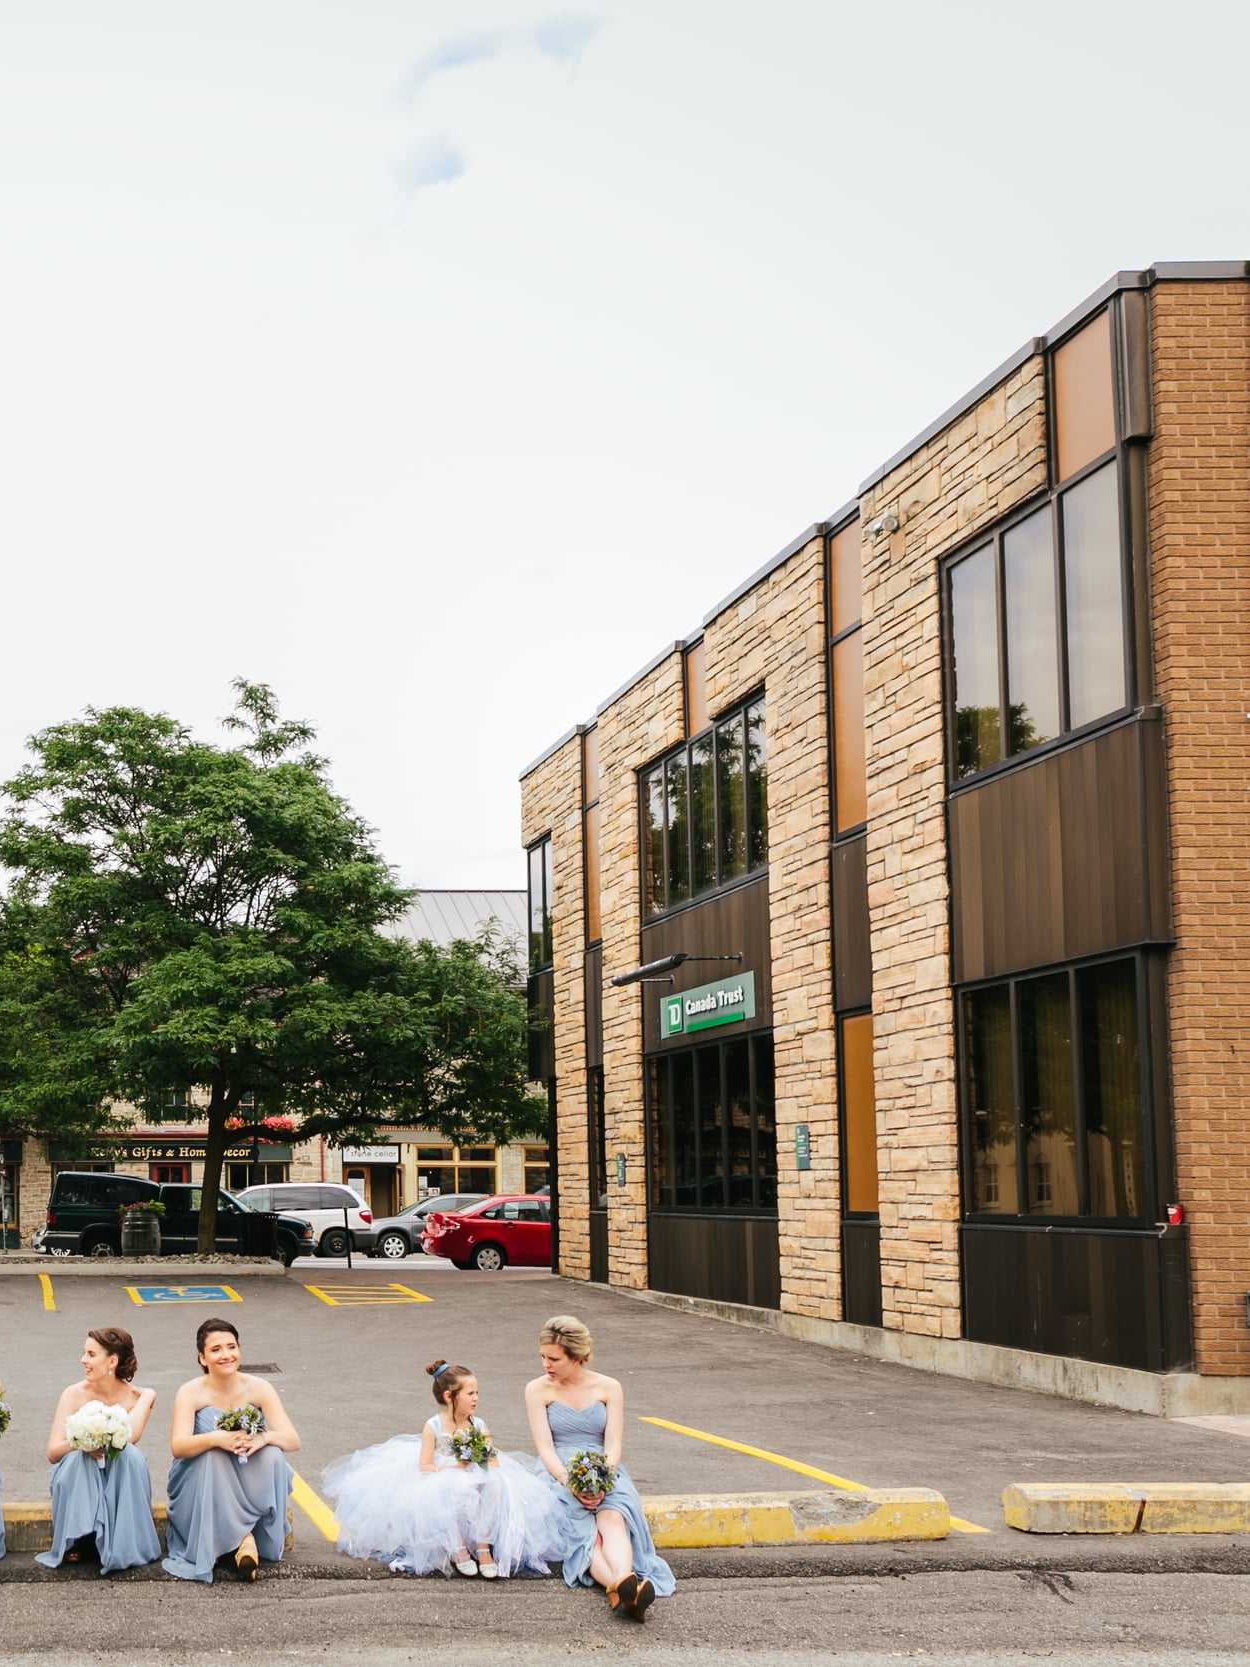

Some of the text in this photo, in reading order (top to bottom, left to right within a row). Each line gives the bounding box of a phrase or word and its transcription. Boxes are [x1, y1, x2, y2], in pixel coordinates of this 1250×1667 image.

[669, 985, 744, 1026] TD Canada Trust
[132, 1146, 162, 1160] Gifts
[165, 1148, 174, 1157] &
[178, 1147, 206, 1157] Hom
